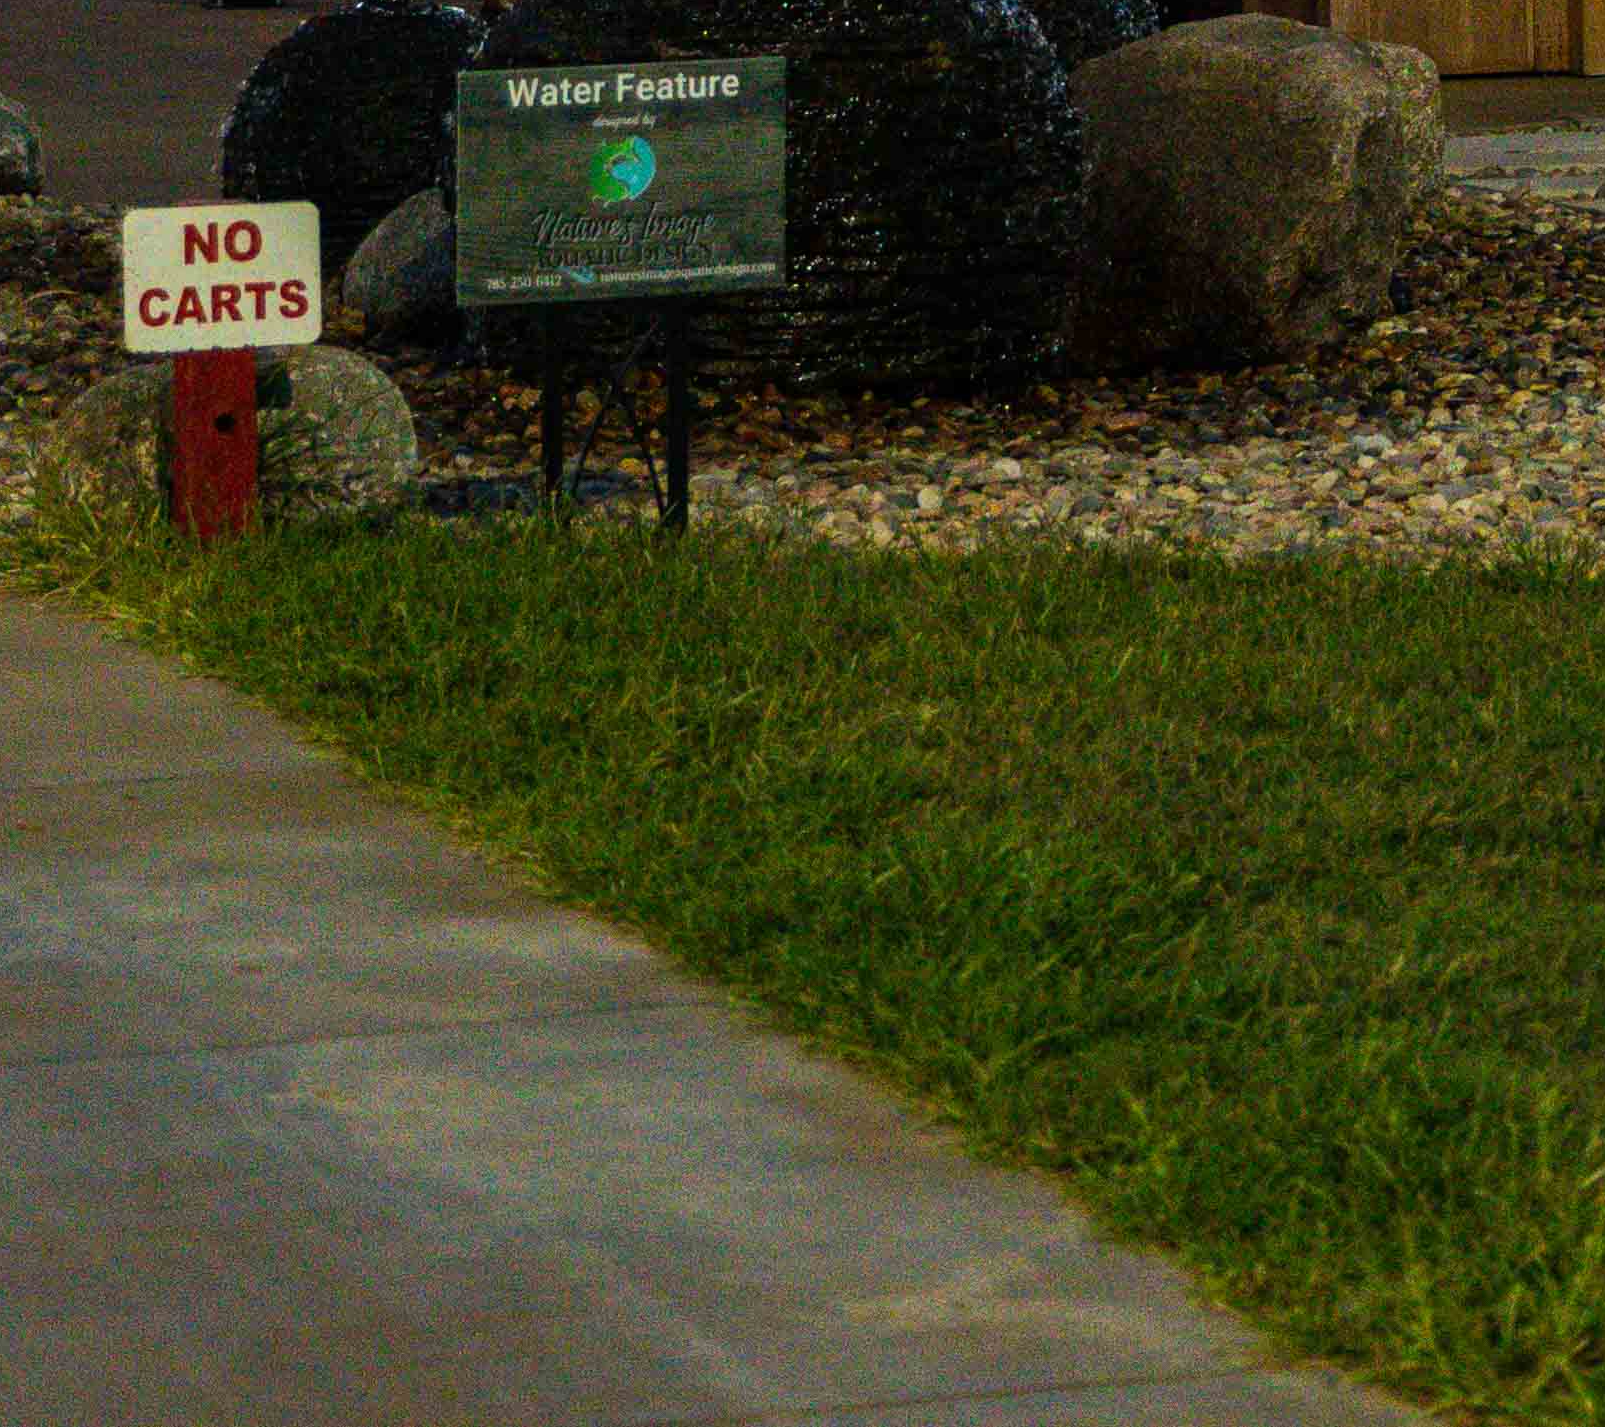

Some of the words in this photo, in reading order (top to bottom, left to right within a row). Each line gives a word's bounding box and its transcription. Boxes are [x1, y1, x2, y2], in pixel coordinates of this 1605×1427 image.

[506, 76, 606, 108] Water
[617, 71, 740, 103] Feature
[183, 219, 263, 266] NO
[138, 279, 309, 328] CARTS
